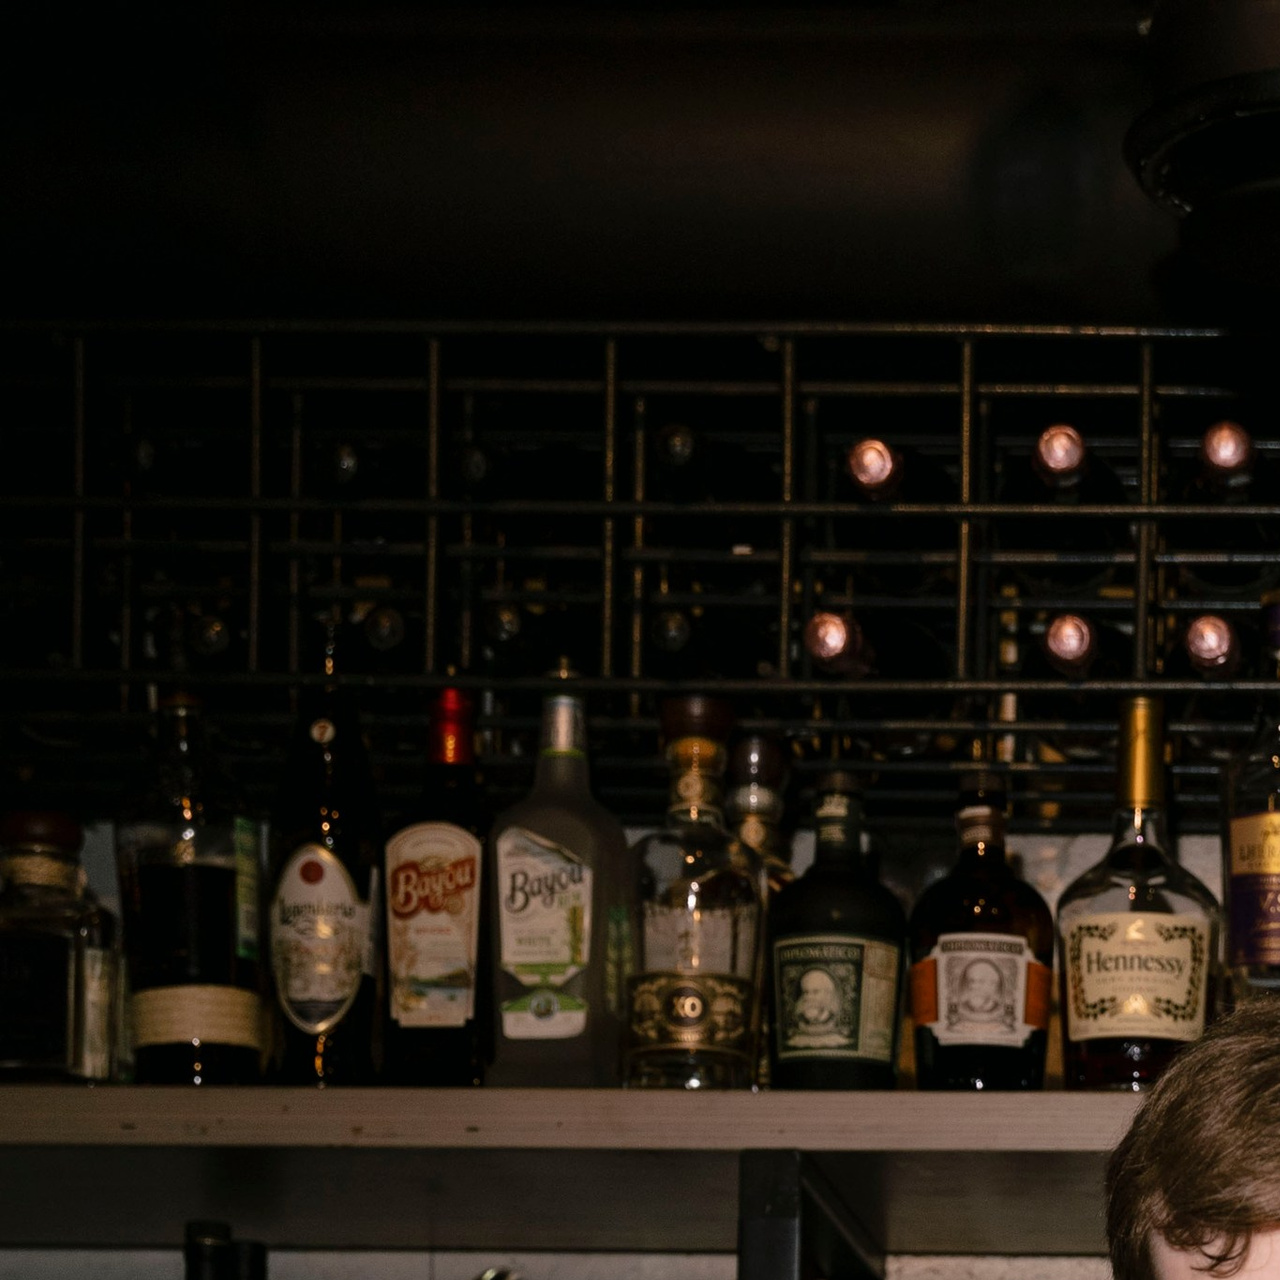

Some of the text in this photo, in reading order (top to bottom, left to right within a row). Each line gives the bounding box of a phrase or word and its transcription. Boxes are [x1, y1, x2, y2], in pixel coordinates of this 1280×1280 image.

[394, 858, 474, 917] Bayou
[505, 864, 584, 913] Bayou
[1086, 951, 1184, 979] Hennessy
